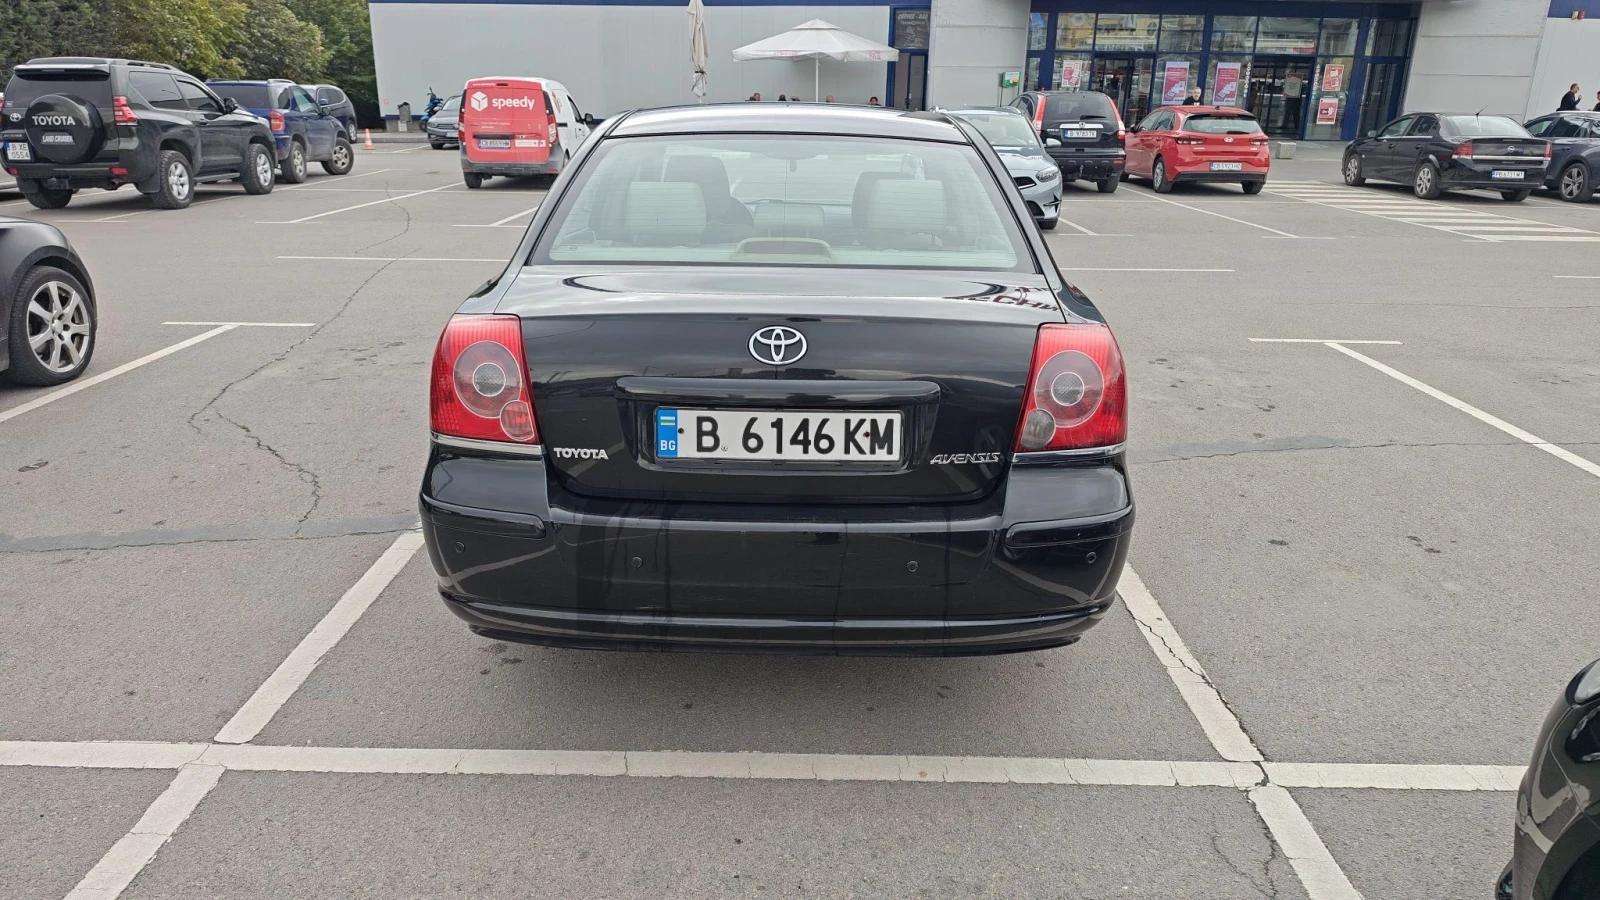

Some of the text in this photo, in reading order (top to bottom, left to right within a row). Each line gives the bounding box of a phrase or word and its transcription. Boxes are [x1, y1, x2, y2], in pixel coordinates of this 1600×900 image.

[491, 95, 535, 110] speedy
[31, 115, 76, 126] TOYOTA
[696, 416, 721, 453] B
[660, 440, 676, 451] BG
[553, 447, 609, 460] TOYOTA
[930, 452, 1001, 465] AVENSIS
